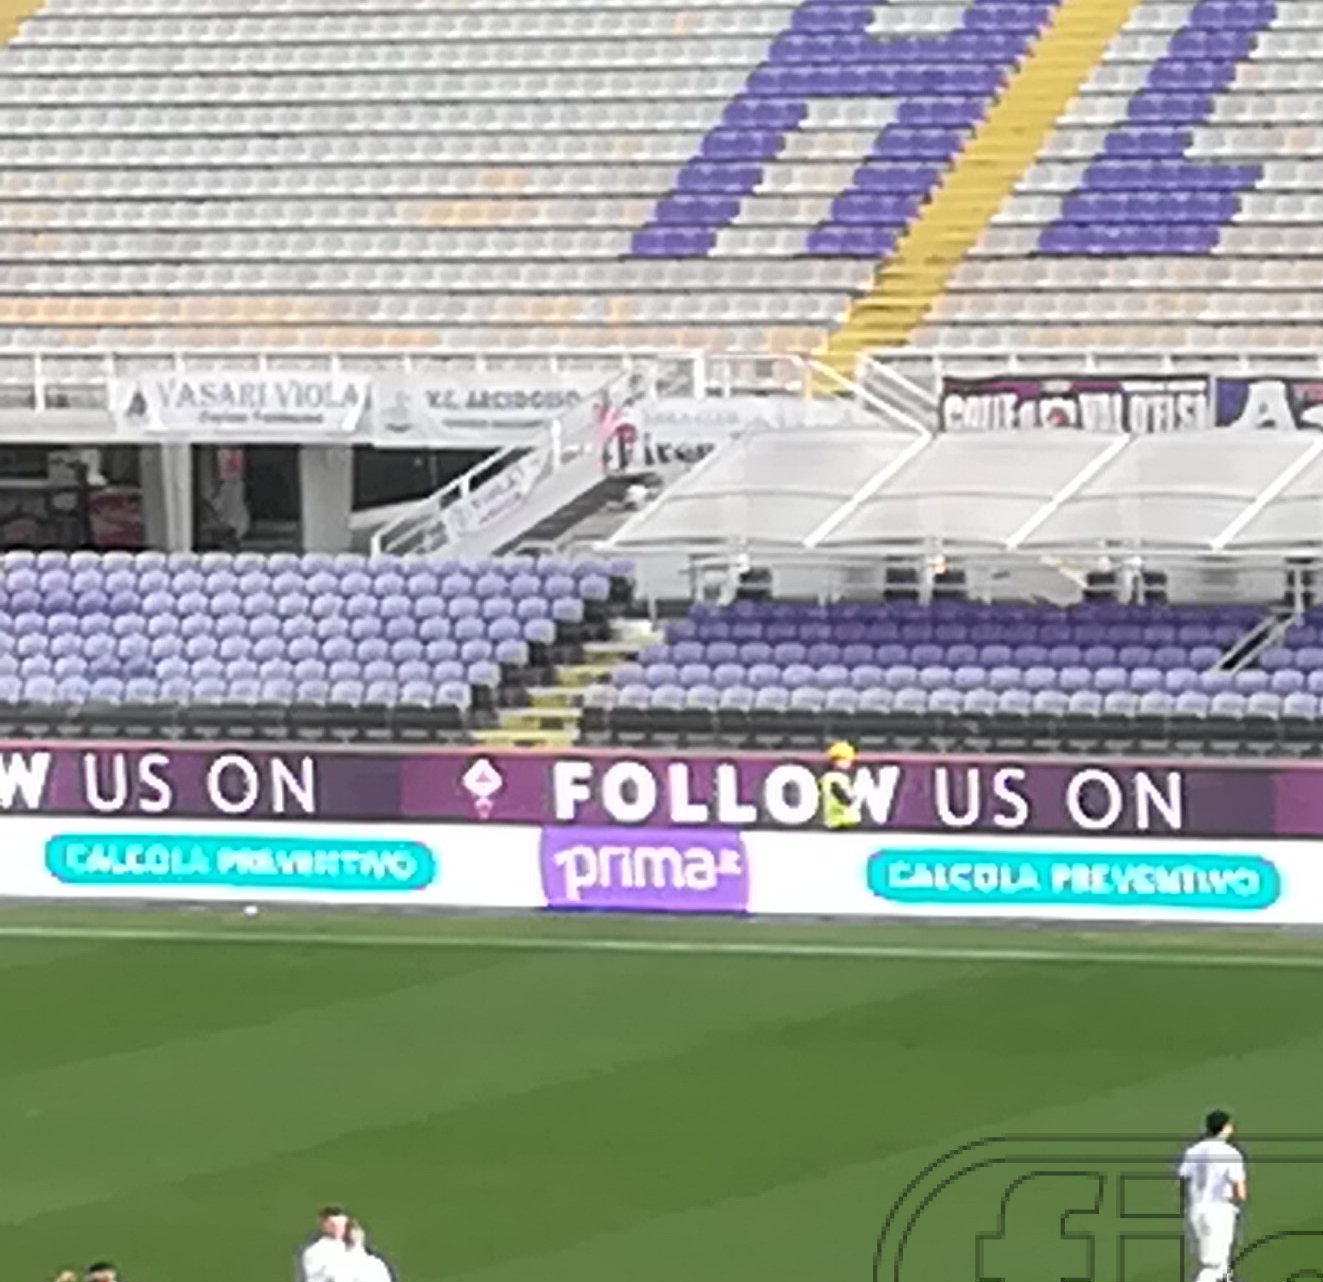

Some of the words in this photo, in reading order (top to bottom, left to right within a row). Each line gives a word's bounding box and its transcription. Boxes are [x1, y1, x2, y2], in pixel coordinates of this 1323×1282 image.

[157, 378, 268, 408] VASARI
[274, 380, 358, 408] VIOLA
[83, 754, 172, 812] US
[207, 753, 316, 813] ON
[934, 766, 1029, 828] US
[1066, 768, 1183, 830] ON
